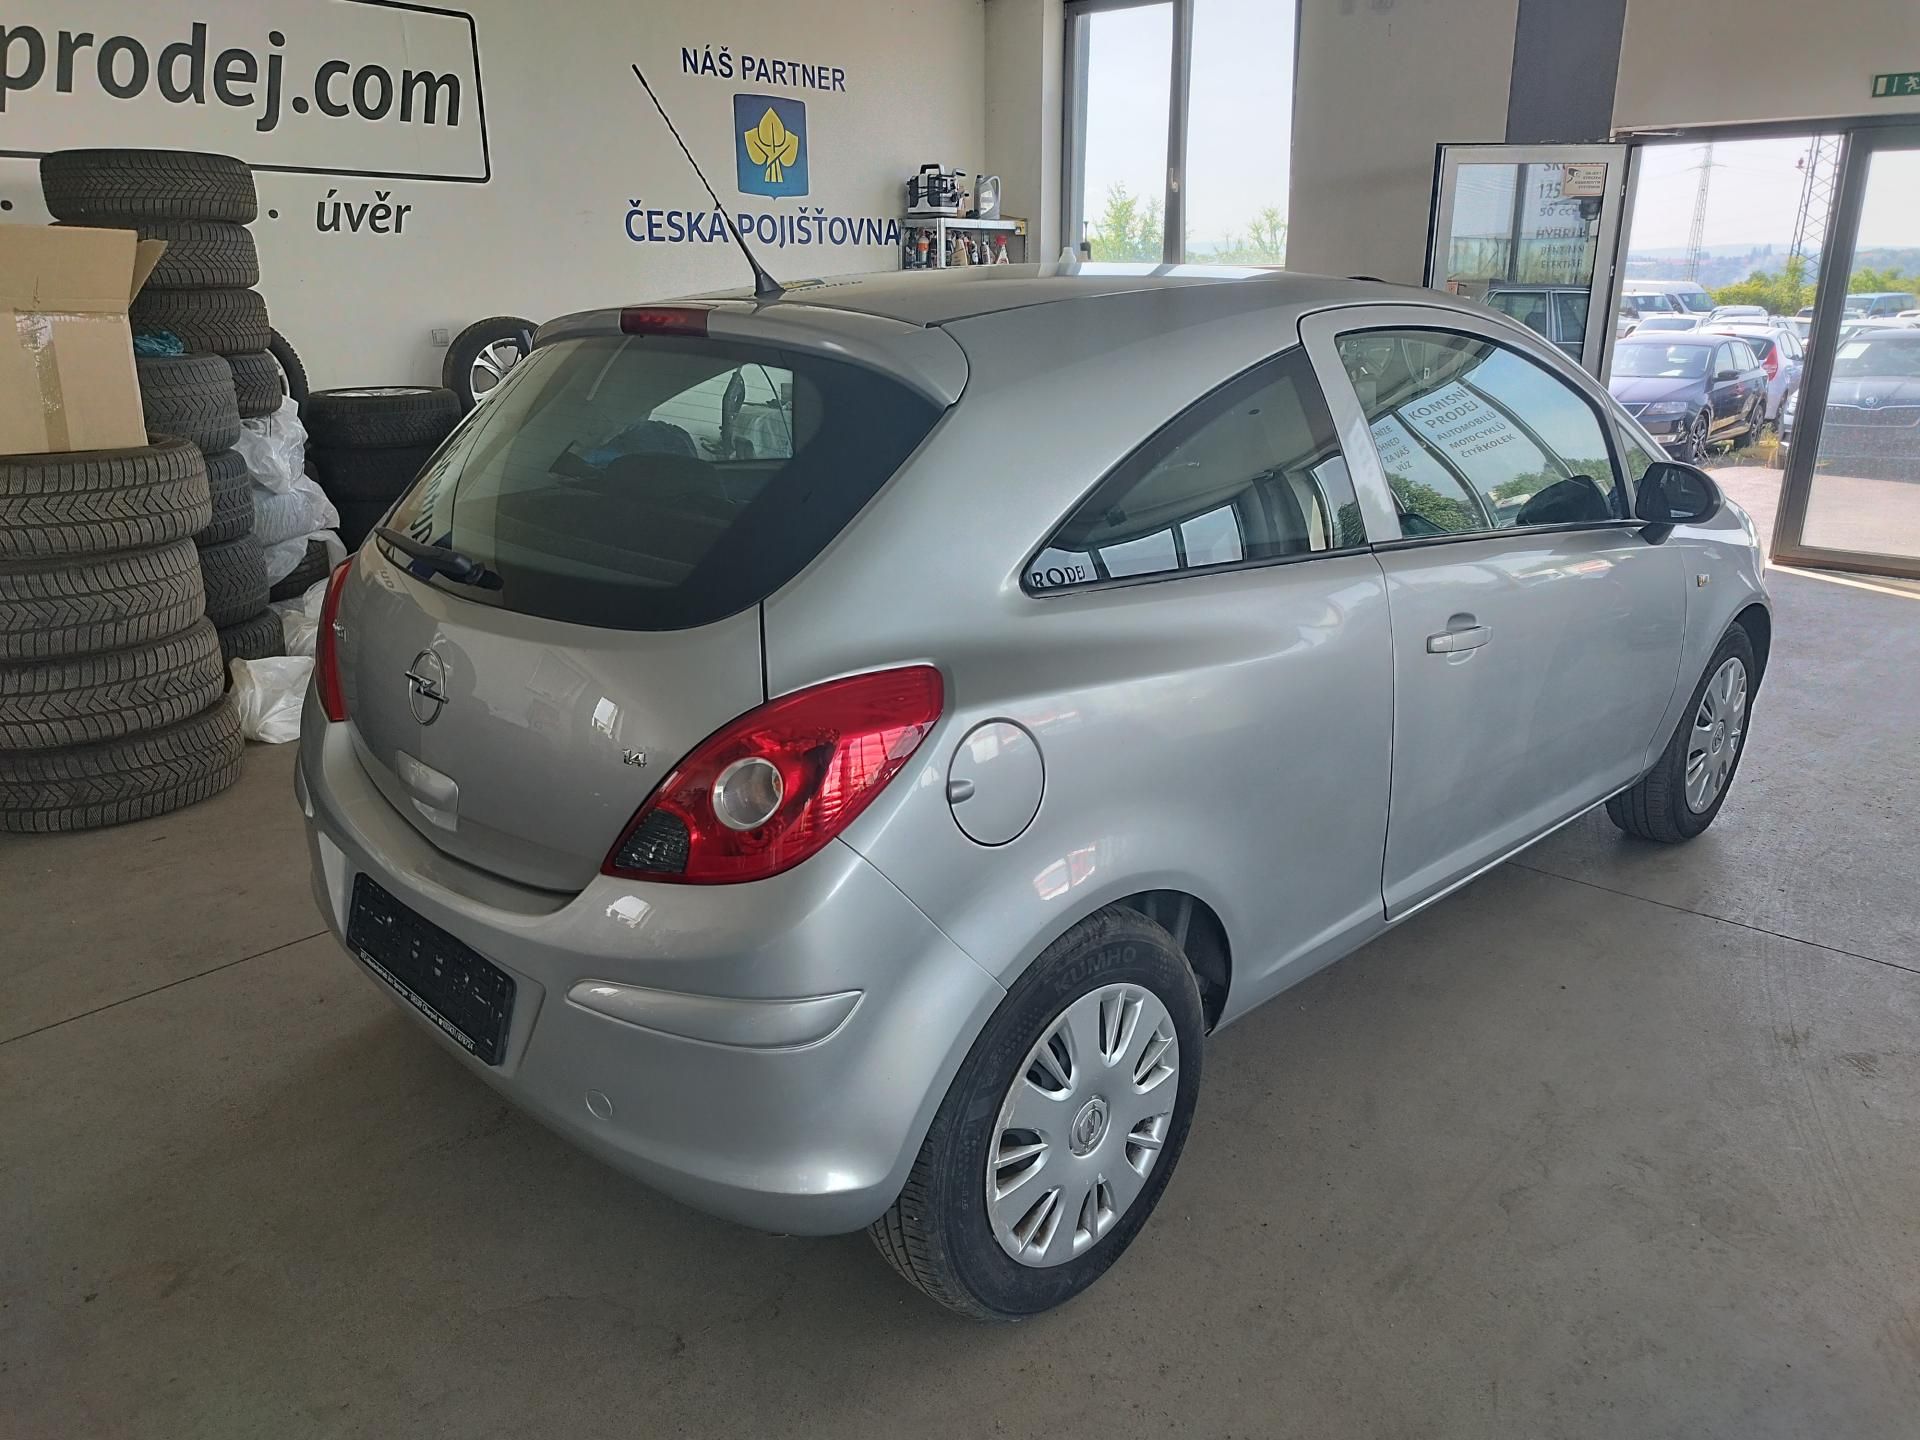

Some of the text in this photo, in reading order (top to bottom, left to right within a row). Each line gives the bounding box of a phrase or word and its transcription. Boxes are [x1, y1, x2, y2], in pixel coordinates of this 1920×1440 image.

[681, 44, 846, 93] NÁŠ PARTNER
[316, 189, 412, 234] úvěr
[625, 200, 900, 249] ČESKÁ POJIŠŤOVNA
[1408, 386, 1469, 421] KOMISNÍ
[1424, 400, 1479, 429] PRODEJ
[1436, 410, 1497, 441] AUTOMOBILŮ
[1449, 422, 1506, 449] MOTOCYKLŮ
[1461, 433, 1516, 458] ČTYŘKOLEK
[1054, 946, 1137, 995] KUMHO
